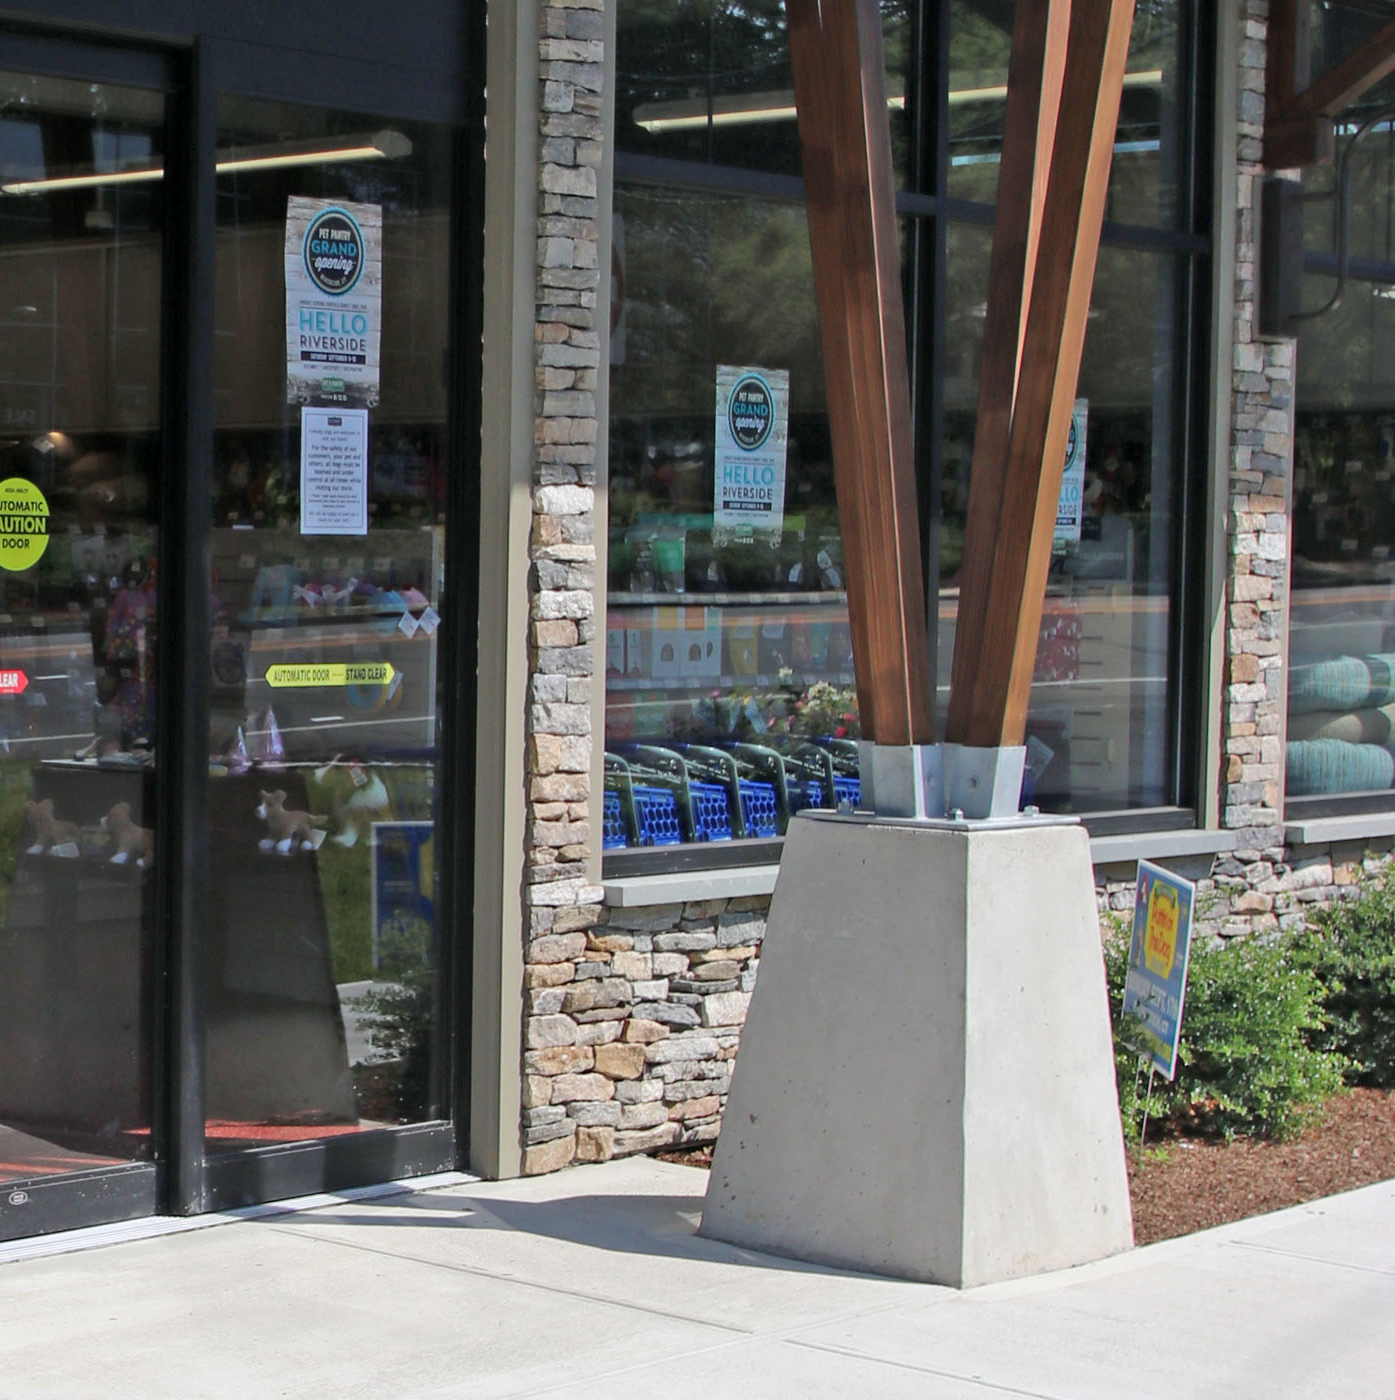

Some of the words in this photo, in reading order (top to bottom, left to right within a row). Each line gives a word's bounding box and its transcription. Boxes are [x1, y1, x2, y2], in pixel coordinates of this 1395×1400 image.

[311, 240, 357, 257] GRAND
[314, 256, 354, 275] opening
[299, 310, 368, 335] HELLO
[300, 334, 366, 352] RIVERSIDE
[733, 402, 768, 416] GRAND
[723, 464, 774, 485] HELLO
[722, 486, 773, 500] RIVERSIDE
[2, 538, 30, 549] DOOR
[273, 669, 311, 682] AUTOMATIC
[312, 669, 330, 681] DOOR
[345, 668, 365, 681] STAND
[367, 667, 388, 680] CLEAR
